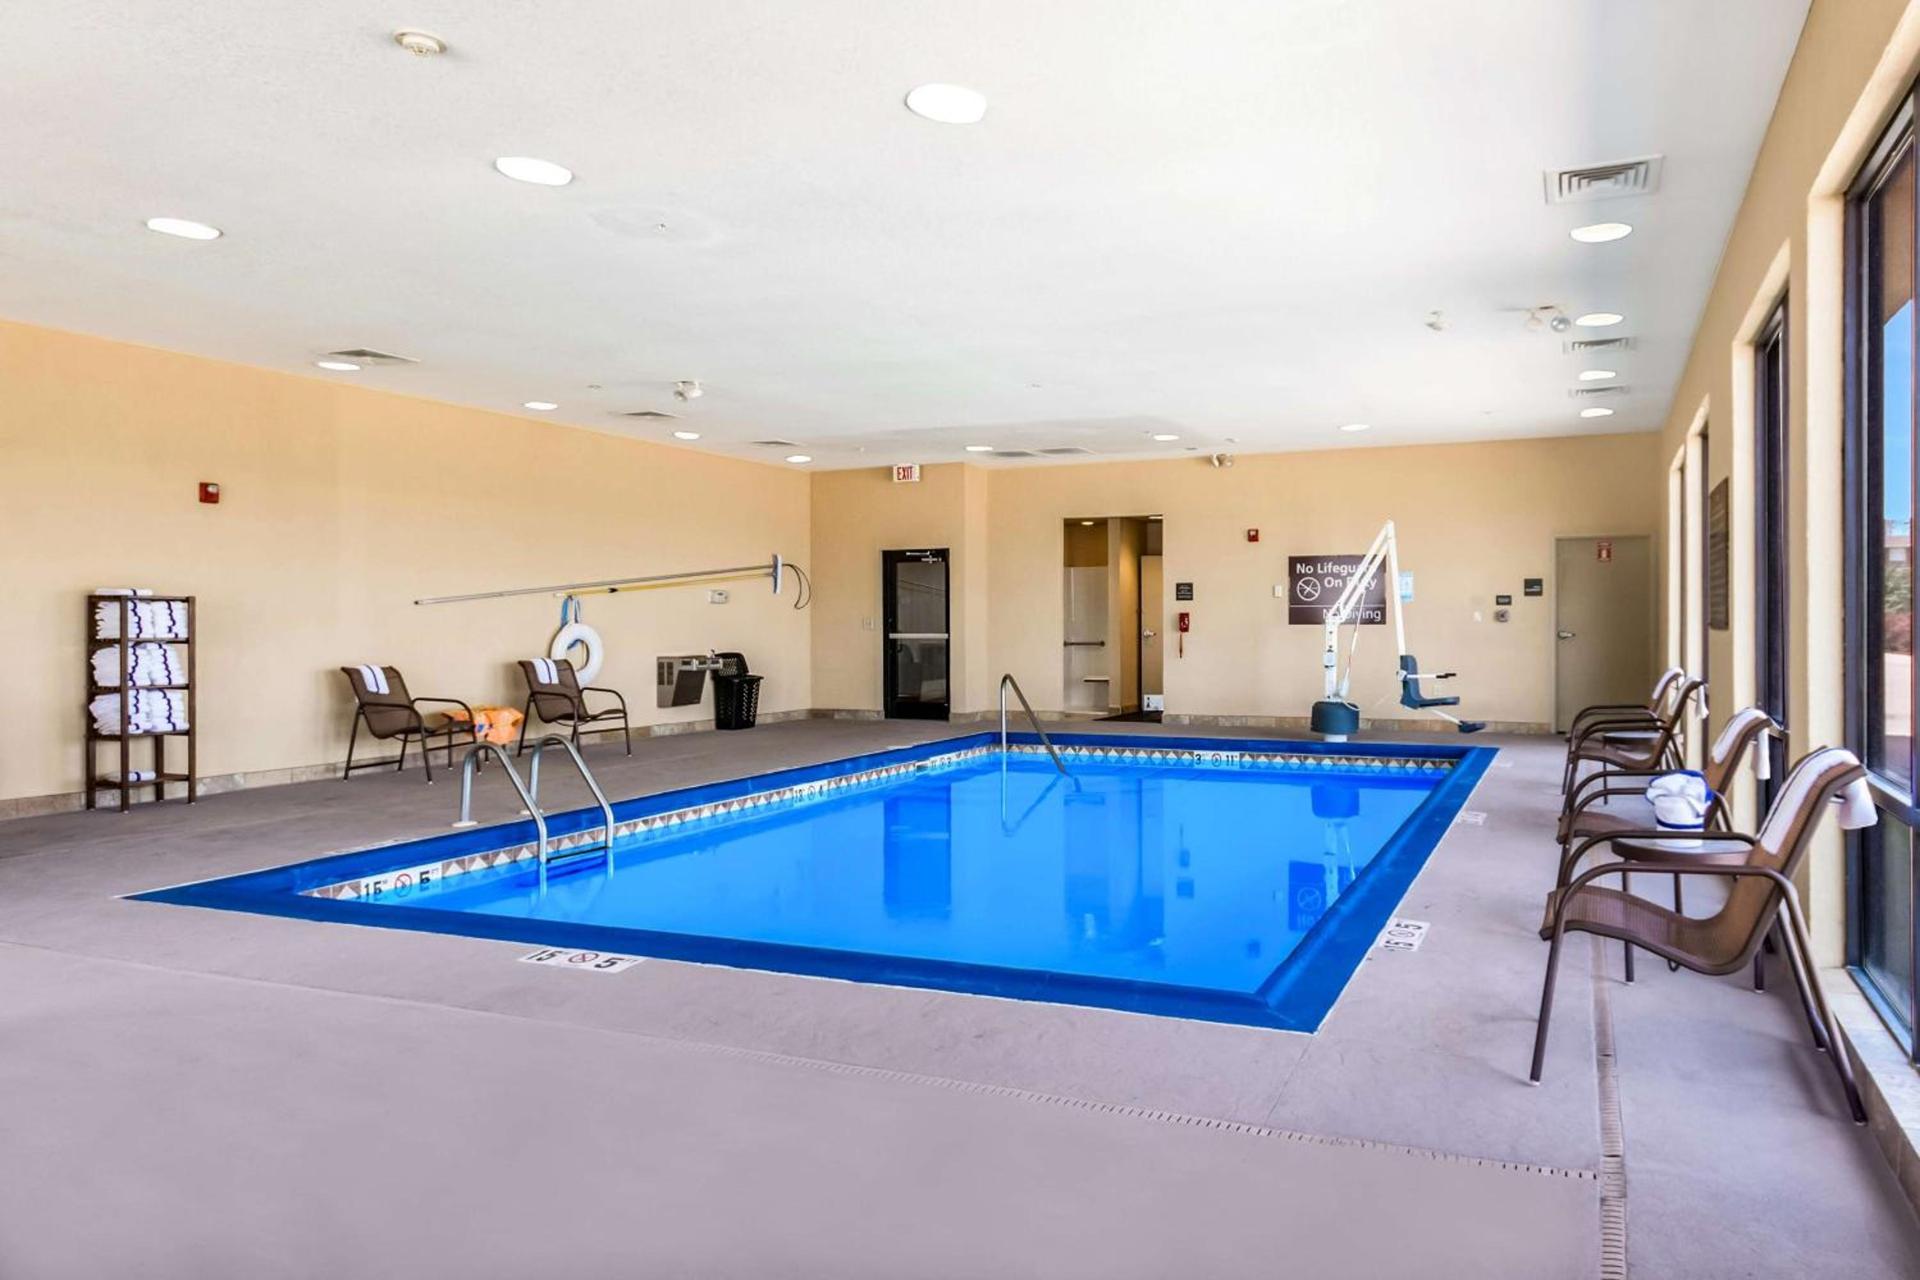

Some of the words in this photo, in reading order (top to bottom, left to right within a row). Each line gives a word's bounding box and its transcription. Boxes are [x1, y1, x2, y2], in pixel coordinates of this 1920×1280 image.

[897, 466, 912, 481] EXIT
[1296, 562, 1314, 574] No
[1316, 561, 1361, 576] Lifegu
[1324, 576, 1343, 588] On
[1194, 753, 1202, 766] 3
[594, 957, 625, 968] 5
